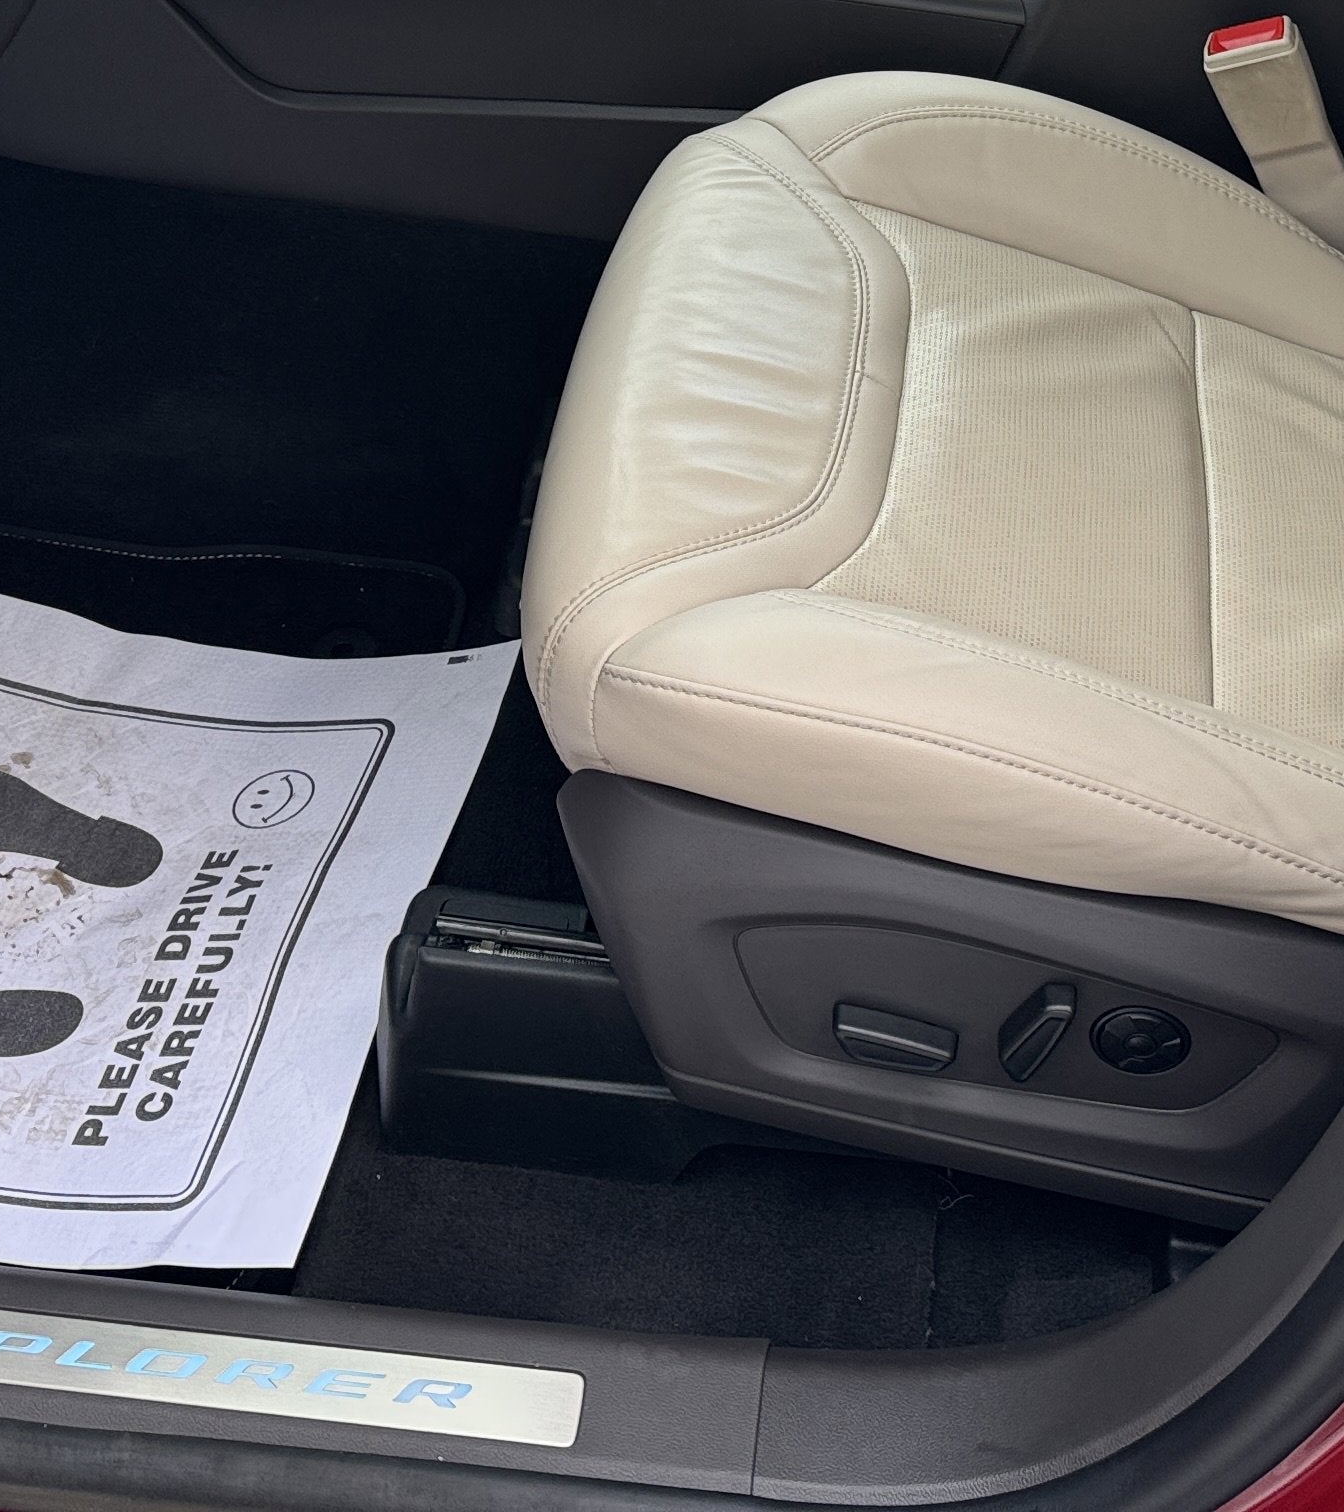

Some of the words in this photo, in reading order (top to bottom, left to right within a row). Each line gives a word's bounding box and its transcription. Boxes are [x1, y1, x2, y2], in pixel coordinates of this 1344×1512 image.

[72, 977, 177, 1146] PLEASE
[154, 848, 239, 961] DRIVE
[135, 863, 273, 1122] CAREFULLY!
